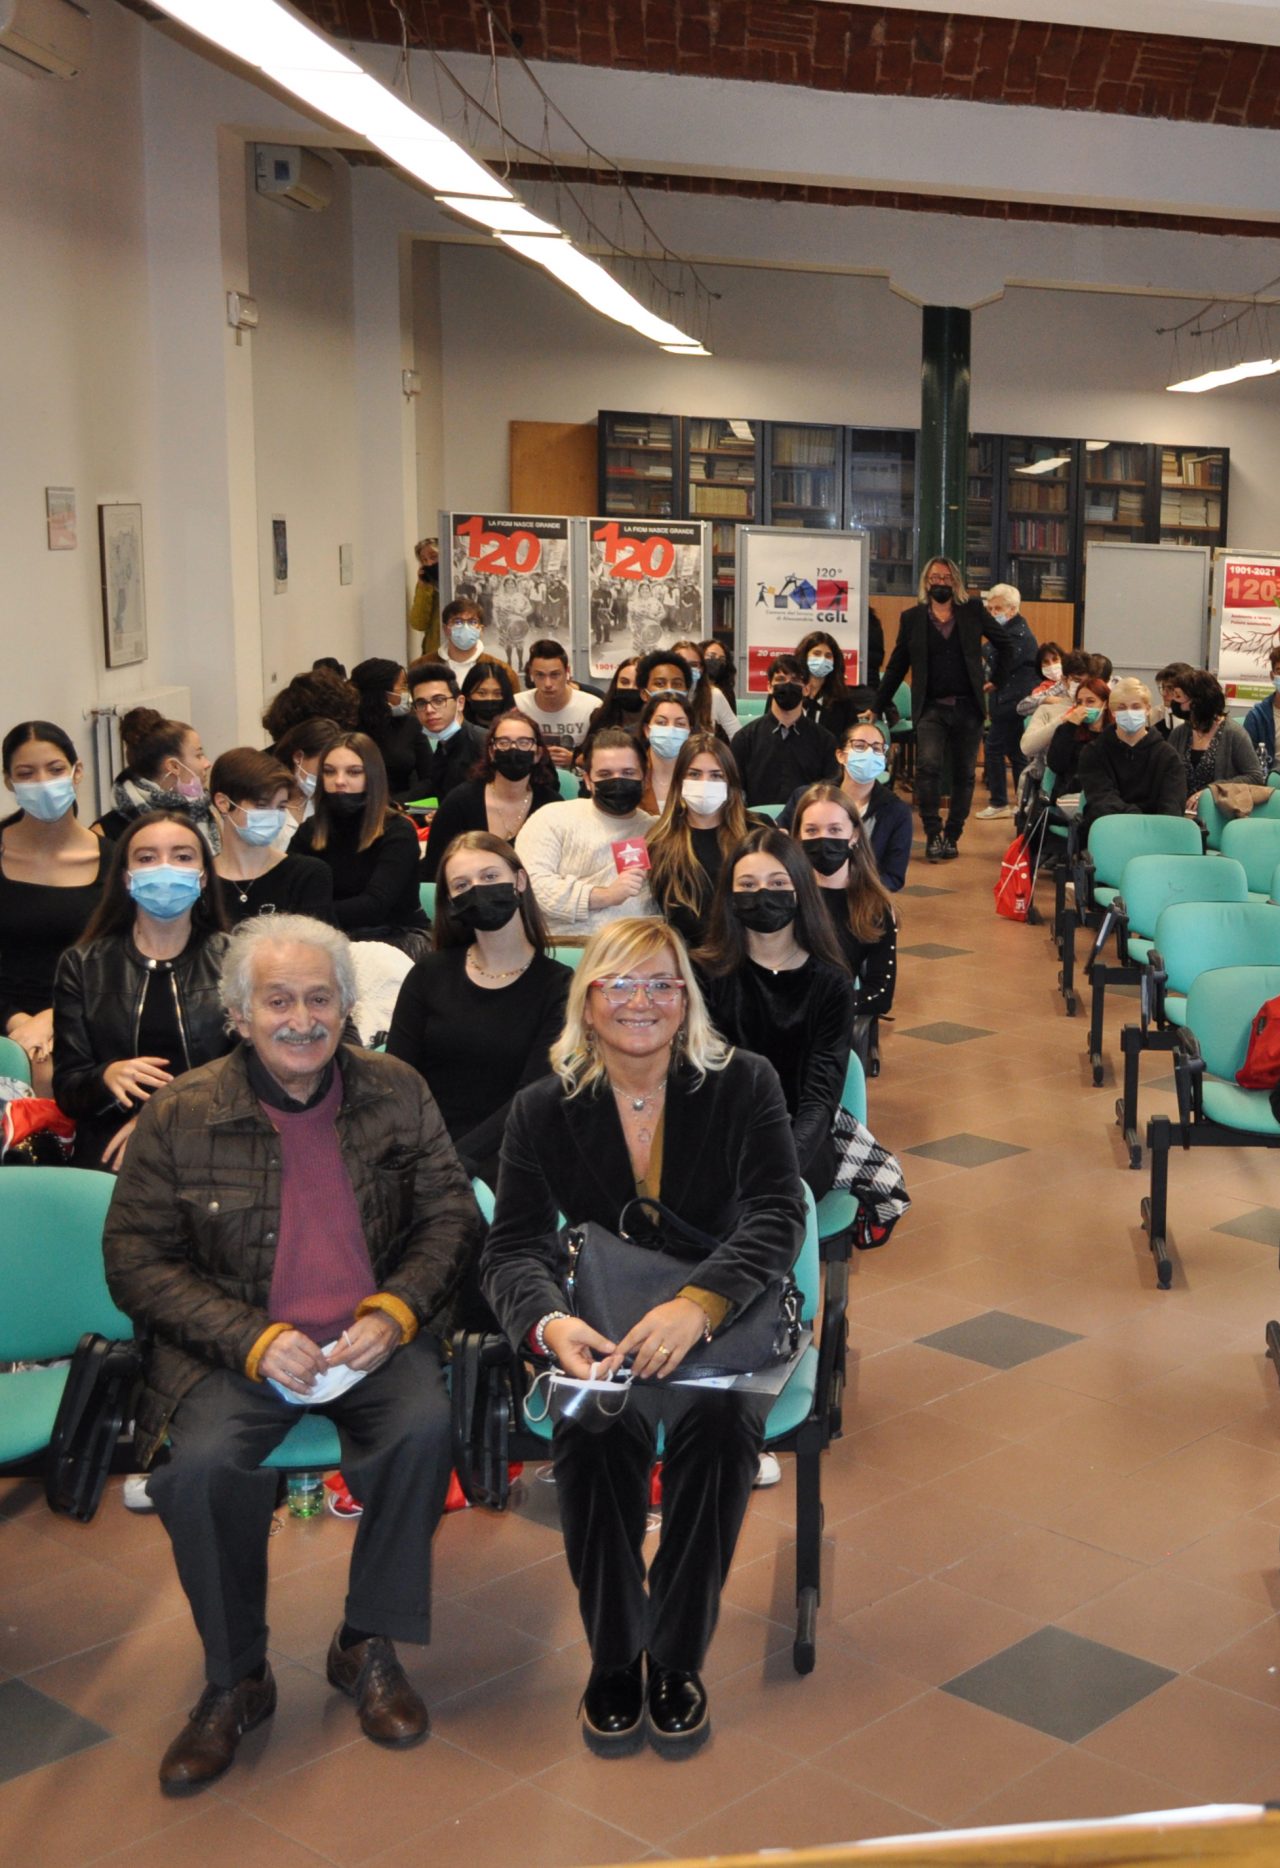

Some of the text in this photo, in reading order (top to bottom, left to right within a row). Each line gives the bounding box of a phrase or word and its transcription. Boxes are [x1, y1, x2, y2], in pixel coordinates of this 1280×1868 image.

[497, 520, 513, 528] FIOM
[513, 520, 534, 529] NASCE
[535, 521, 561, 530] GRANDE
[669, 527, 695, 536] GRANDE
[456, 516, 541, 576] 120
[594, 521, 675, 580] 120
[1229, 565, 1276, 577] 1901-2021
[1227, 577, 1277, 602] 120
[816, 611, 848, 623] CGIL
